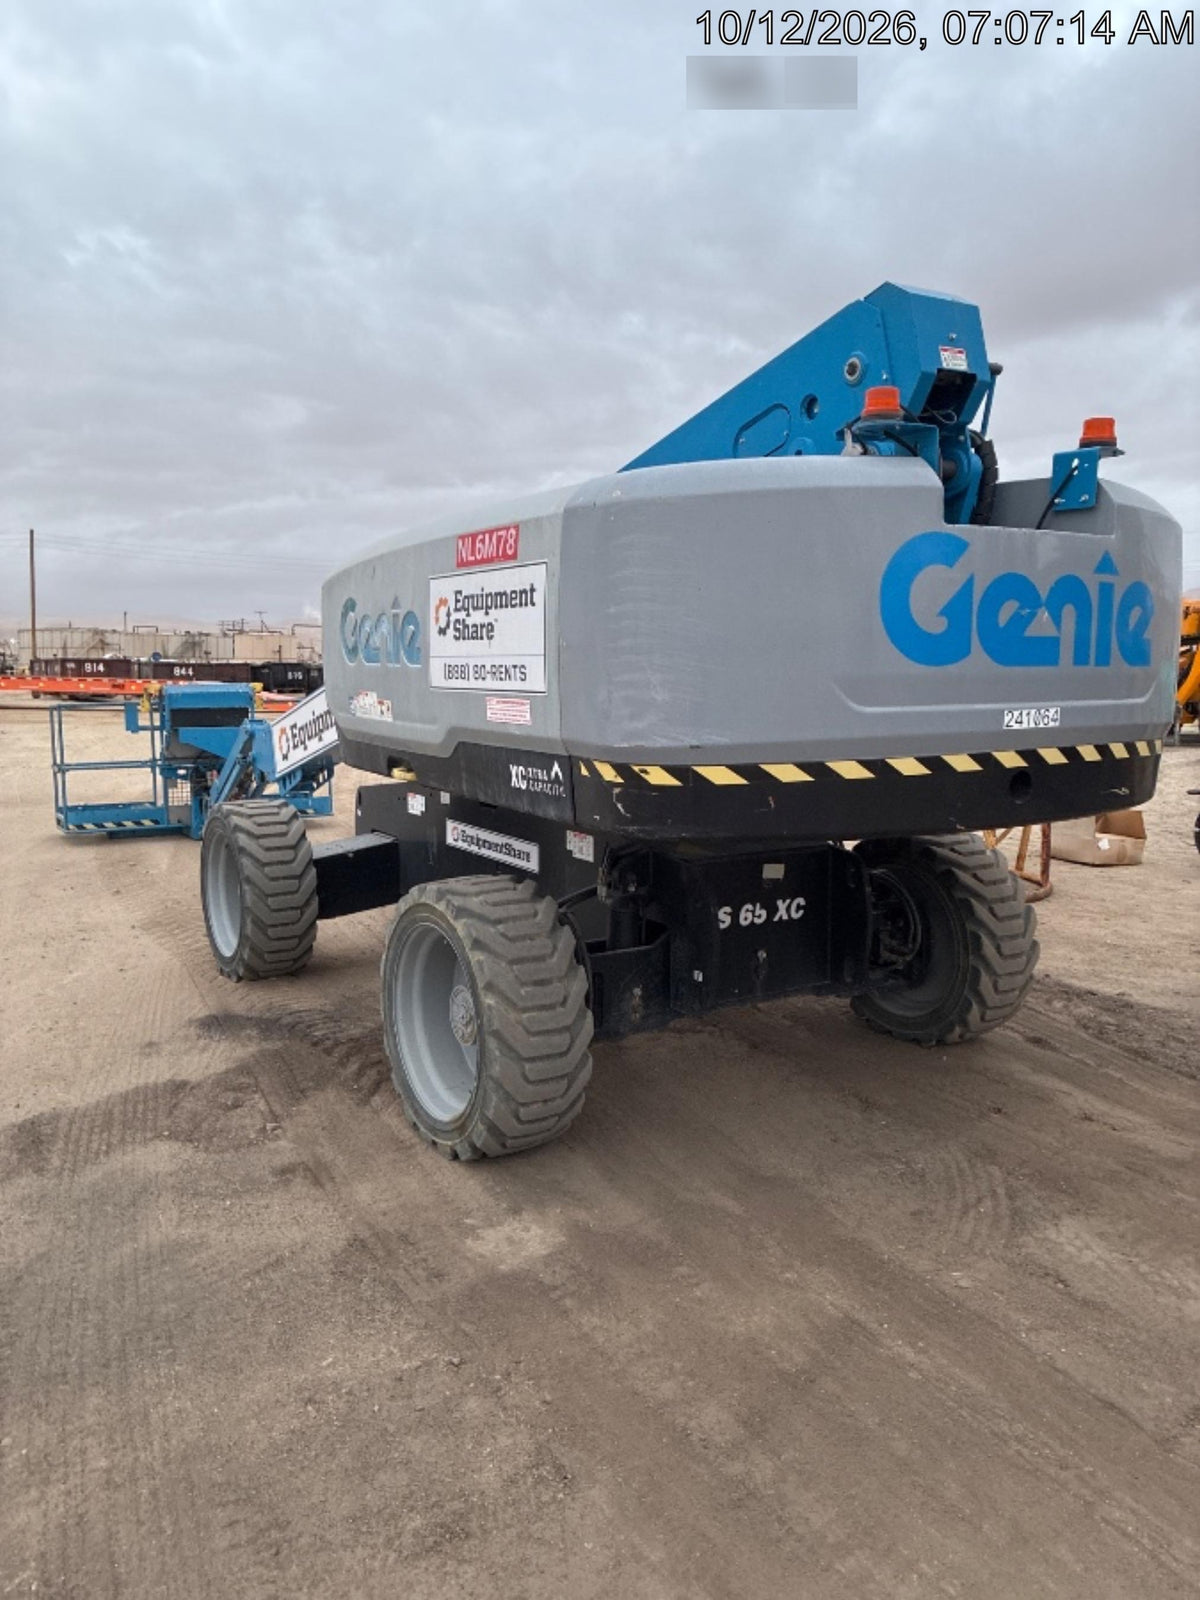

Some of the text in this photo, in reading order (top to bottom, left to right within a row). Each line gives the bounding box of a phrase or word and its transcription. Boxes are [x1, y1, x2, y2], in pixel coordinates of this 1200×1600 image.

[457, 528, 517, 563] NL6M78
[453, 583, 536, 617] Equipment
[880, 531, 1154, 667] Genie
[340, 595, 422, 667] Genie
[84, 662, 105, 673] 814
[473, 664, 527, 682] 80-RENTS
[1006, 709, 1059, 728] 241064
[509, 764, 527, 790] XC
[460, 829, 532, 863] EquipmentShare
[717, 897, 807, 930] S 65 XC
